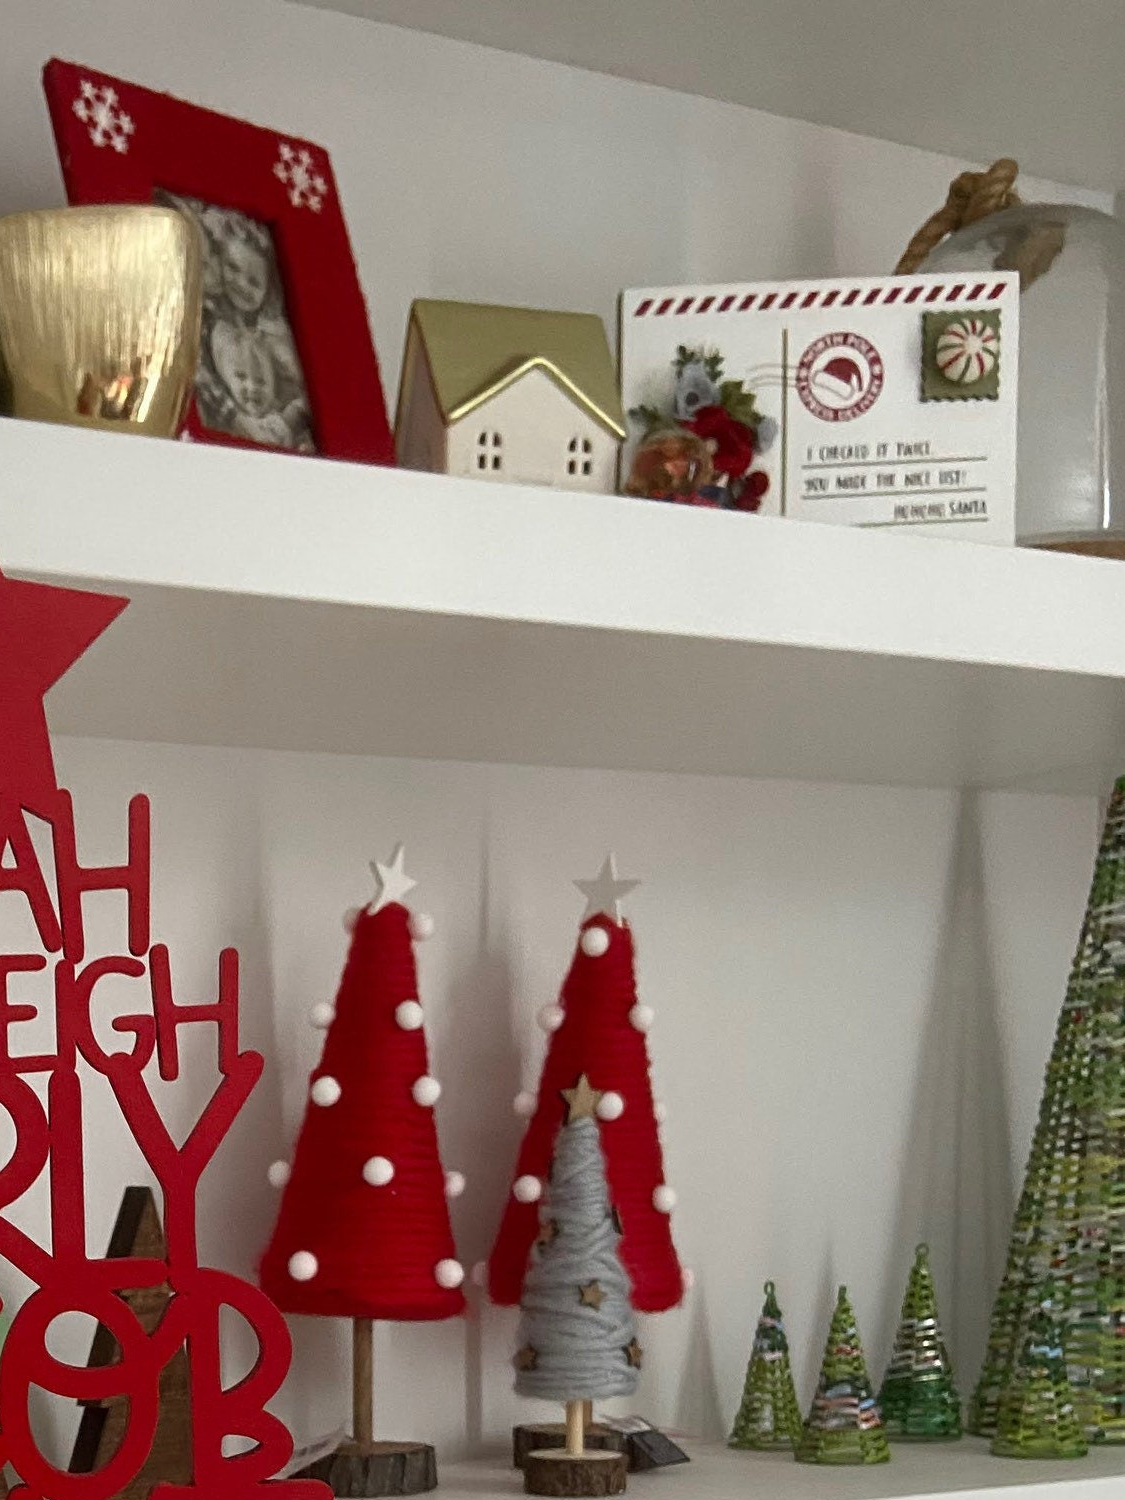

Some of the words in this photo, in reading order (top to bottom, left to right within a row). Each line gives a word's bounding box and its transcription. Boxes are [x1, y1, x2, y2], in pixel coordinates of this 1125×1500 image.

[807, 445, 813, 461] I
[876, 442, 888, 457] IT
[804, 476, 830, 491] YOU
[877, 472, 896, 487] THE
[904, 471, 931, 486] NICE
